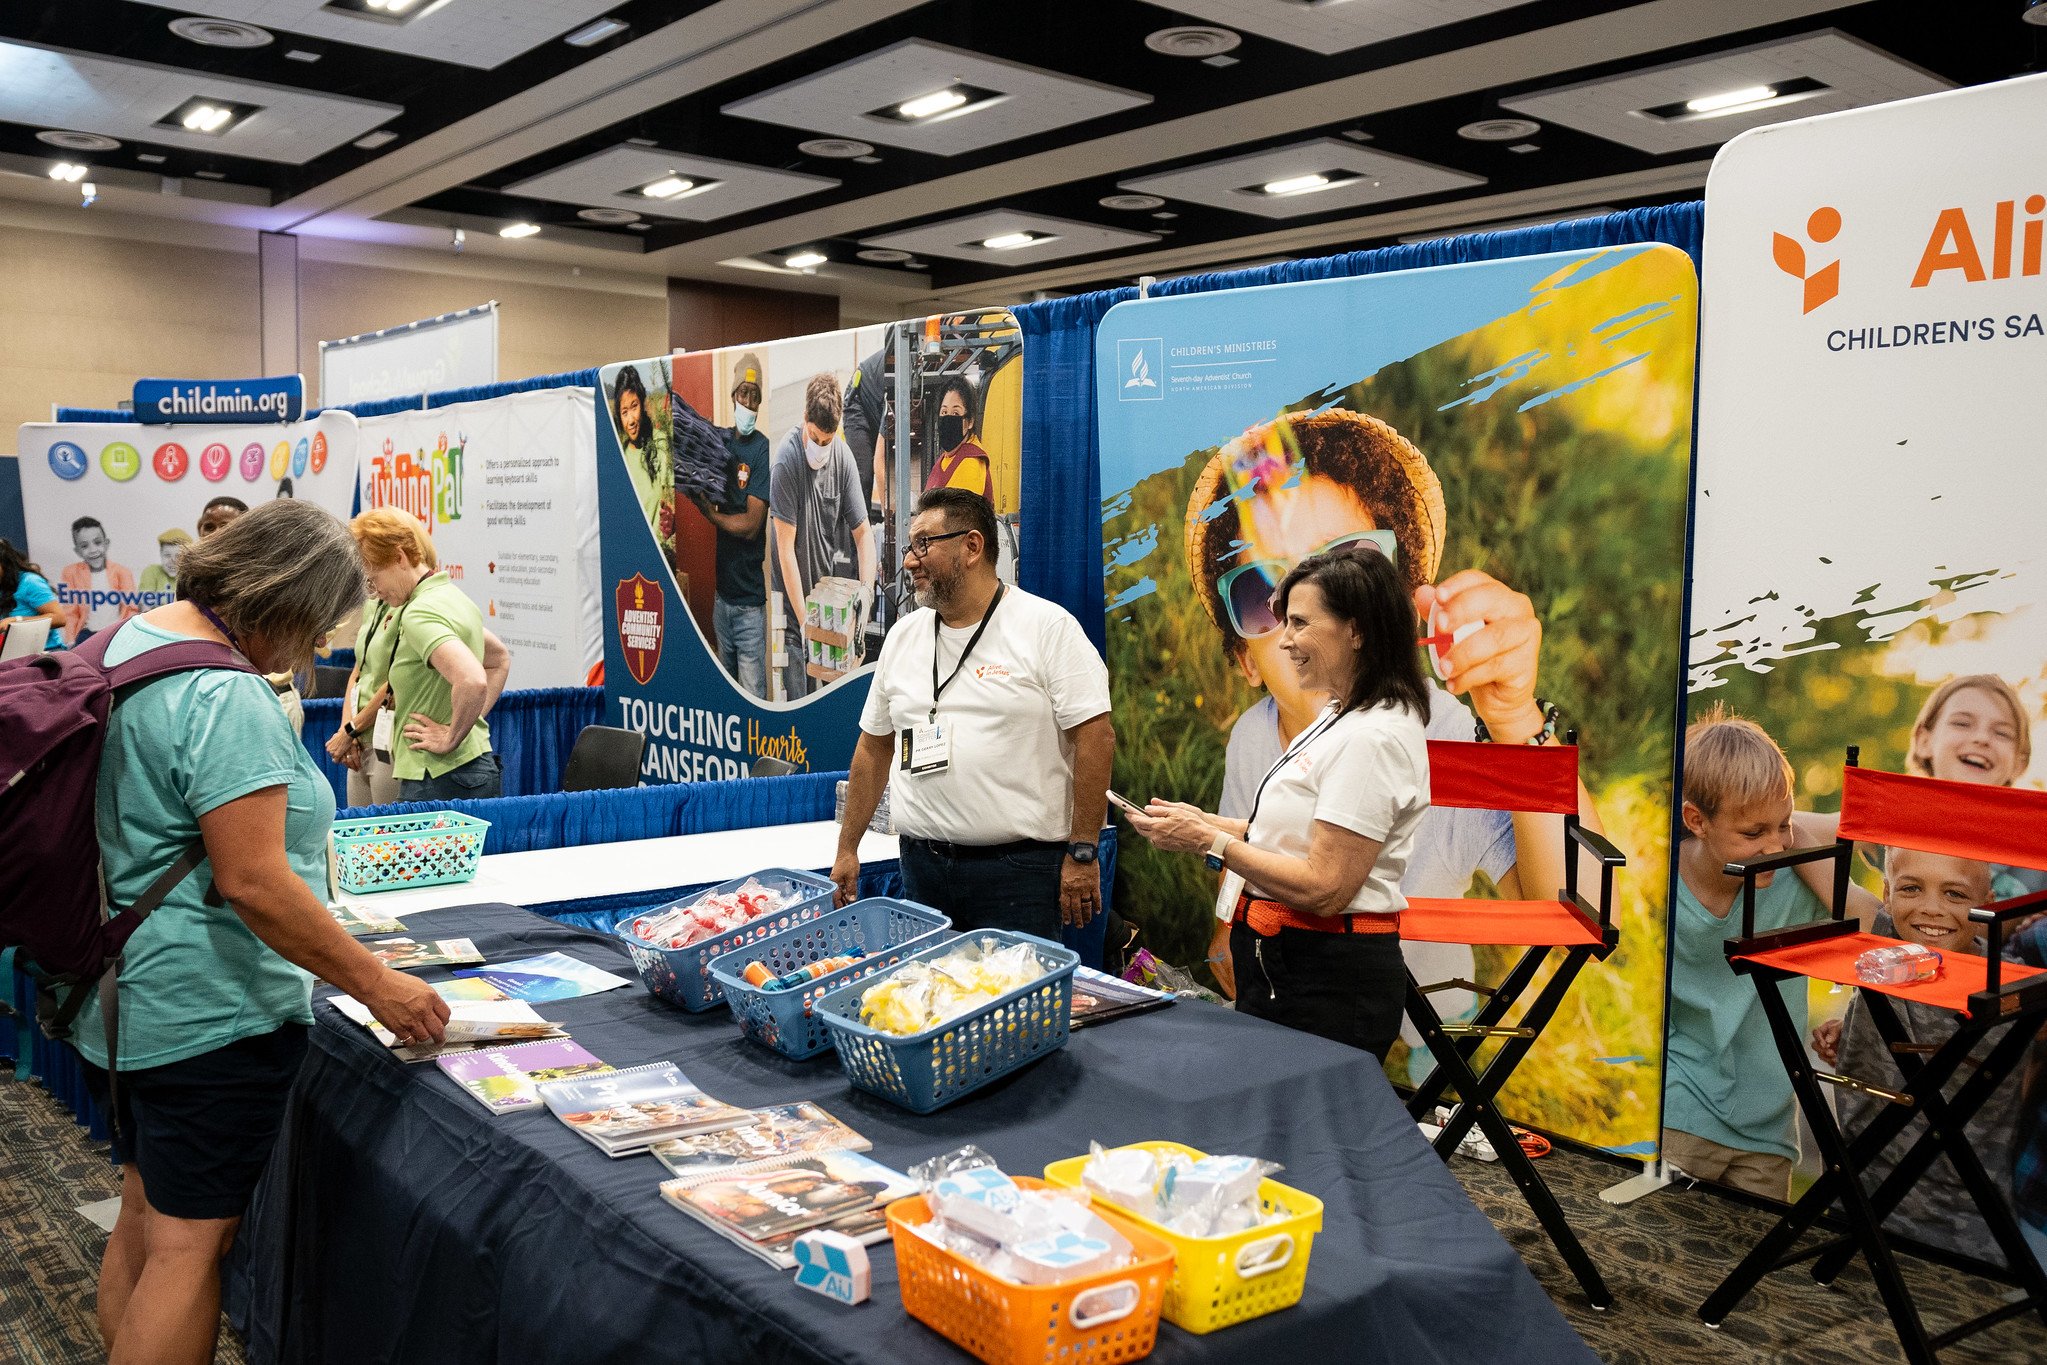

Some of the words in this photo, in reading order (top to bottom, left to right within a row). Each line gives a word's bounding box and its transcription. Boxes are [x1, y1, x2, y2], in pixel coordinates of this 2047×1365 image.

[1910, 194, 2046, 288] Ali
[1827, 317, 1995, 352] CHILDREN'S
[2004, 313, 2046, 339] SA
[1171, 344, 1222, 357] CHILDREN'S
[1224, 340, 1277, 354] MINISTRIES
[1171, 375, 1203, 384] Seventh-day
[1205, 373, 1230, 382] Adventist
[1232, 372, 1252, 380] Church
[158, 386, 288, 417] childmin.org
[532, 456, 554, 469] approach
[624, 609, 658, 625] ADVENTIST
[621, 621, 661, 638] COMMUNITY
[627, 635, 656, 650] SERVICES
[619, 696, 742, 753] TOUCHING
